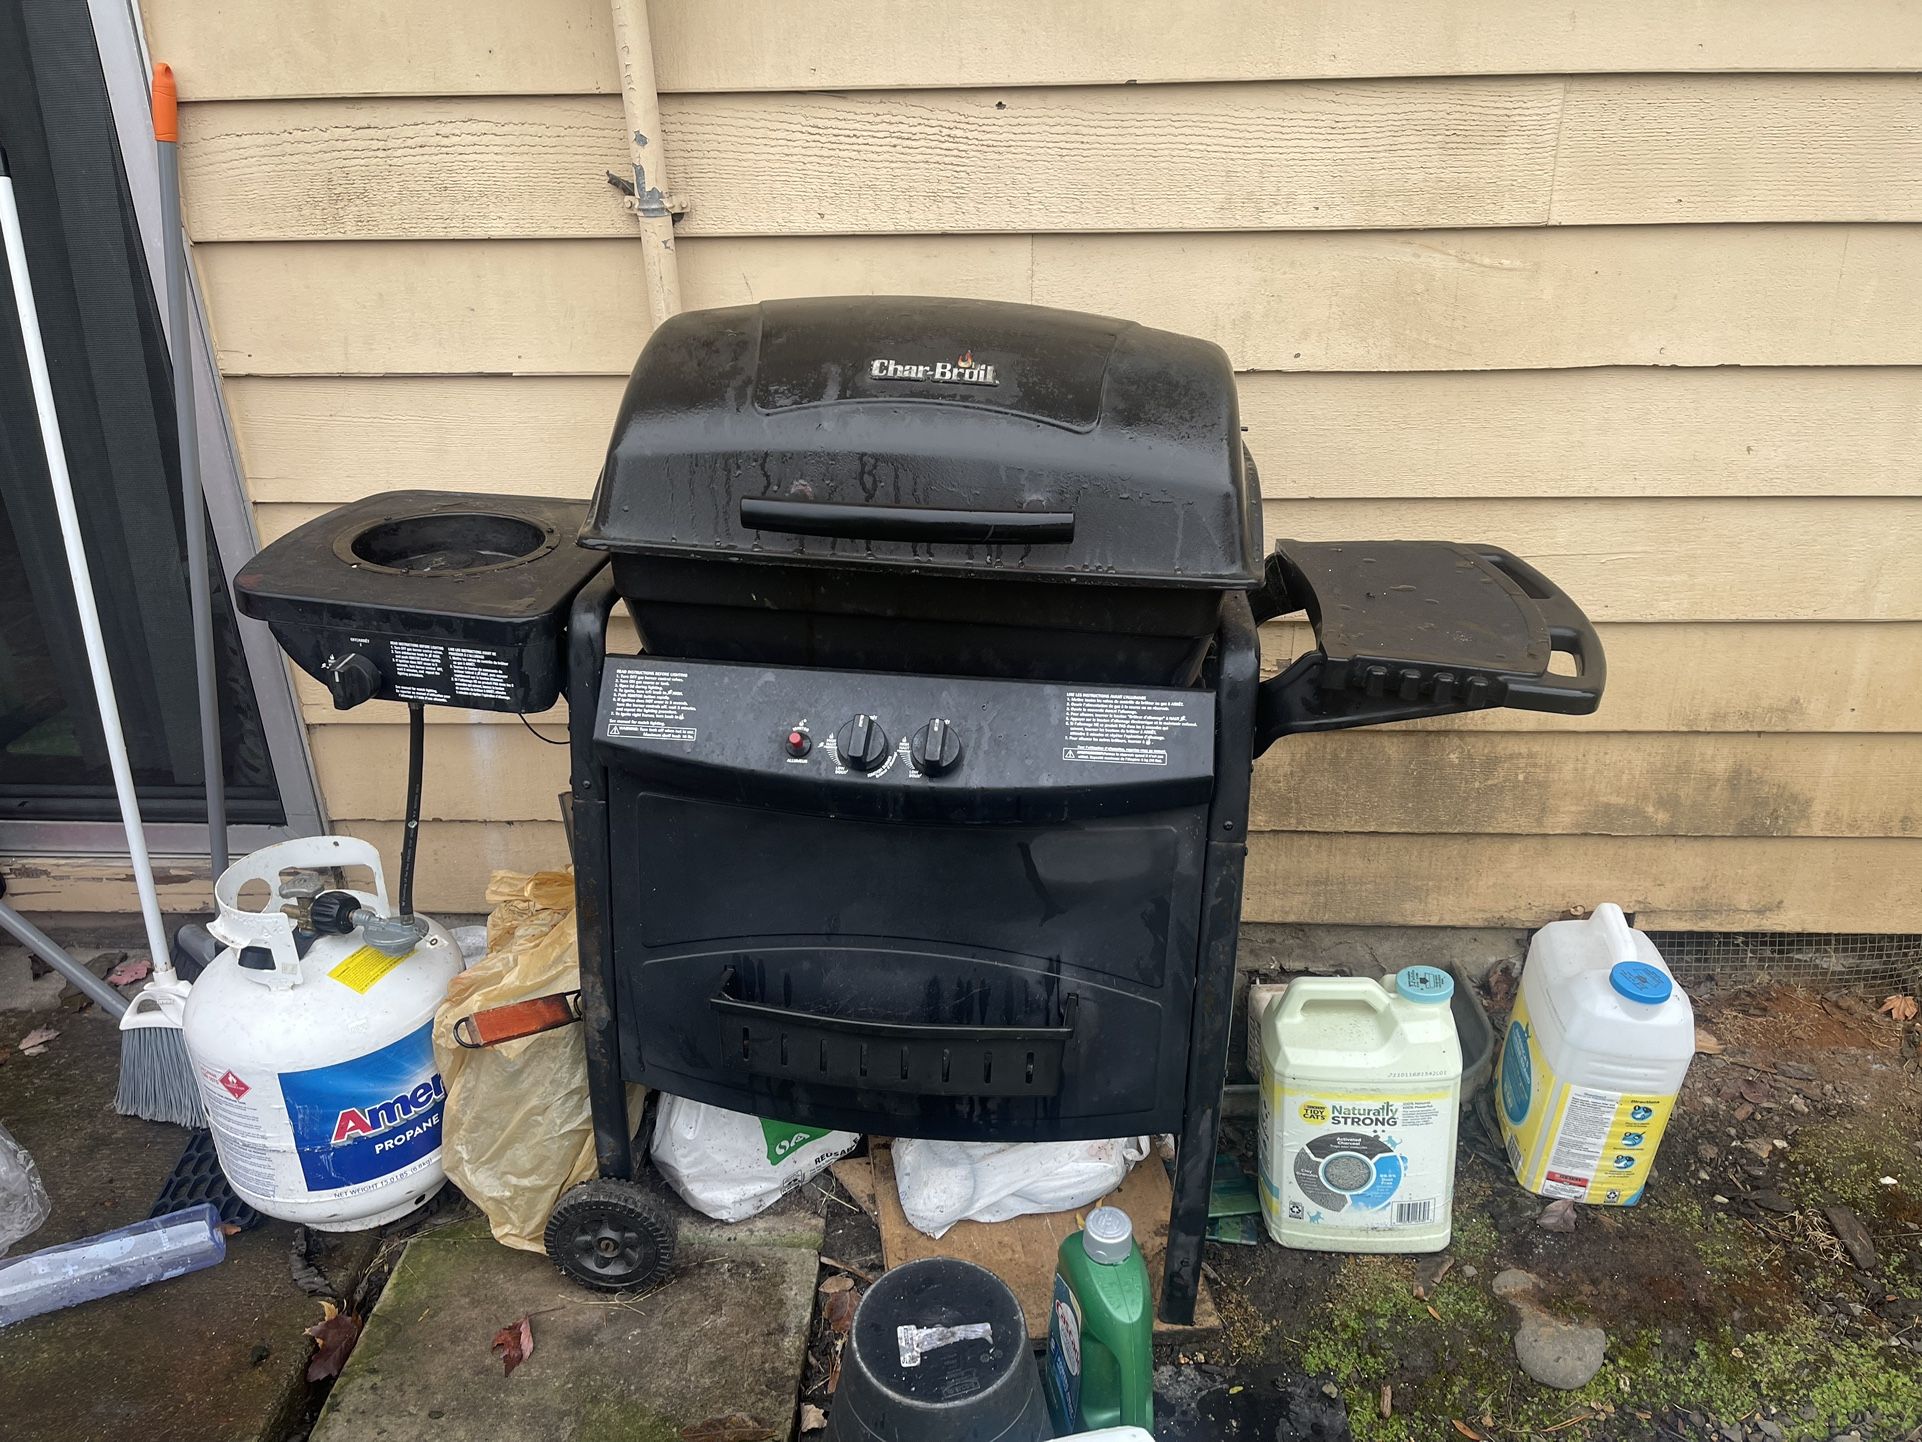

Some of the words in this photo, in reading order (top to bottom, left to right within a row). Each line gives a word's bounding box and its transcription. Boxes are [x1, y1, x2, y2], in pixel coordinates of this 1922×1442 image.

[871, 359, 995, 383] Char-Broil
[1332, 1102, 1398, 1118] Naturally
[1332, 1116, 1397, 1126] STRONG
[374, 1113, 440, 1154] PROPANE
